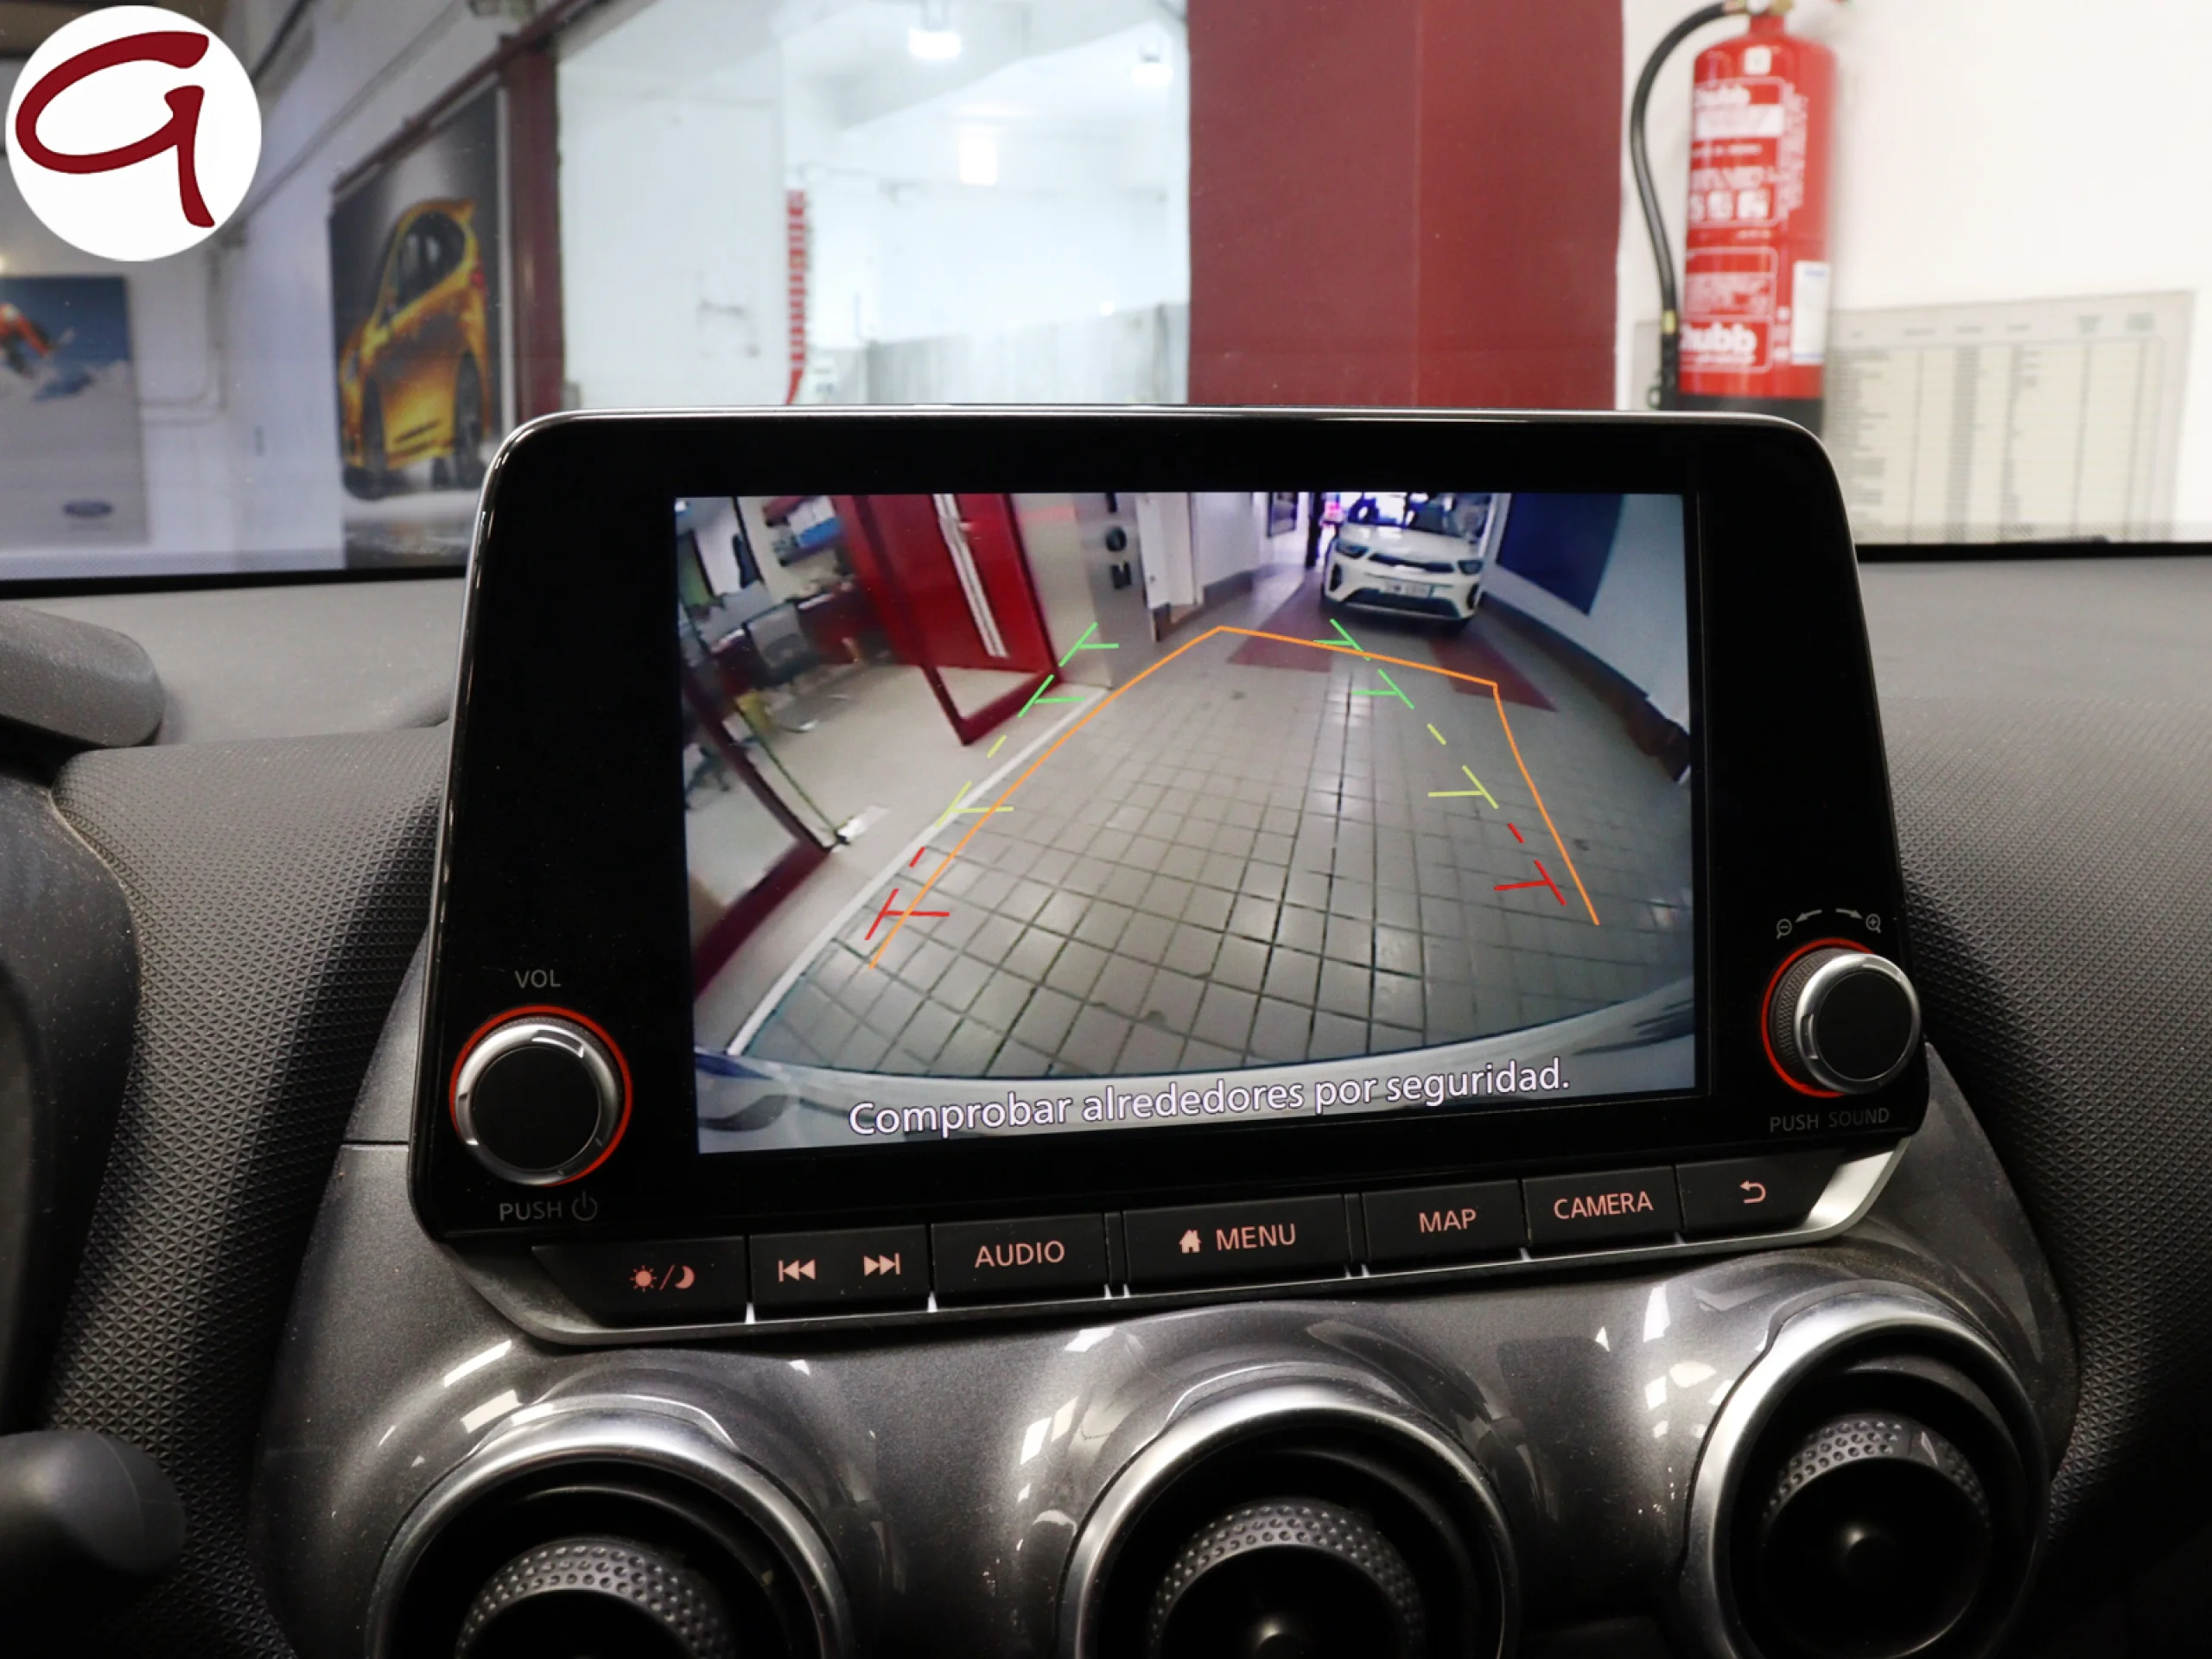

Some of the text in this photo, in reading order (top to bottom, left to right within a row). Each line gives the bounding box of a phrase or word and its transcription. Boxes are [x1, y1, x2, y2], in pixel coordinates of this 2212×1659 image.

[514, 969, 561, 988] VOL
[849, 1057, 1570, 1139] Comprobar alrededores por seguridad.
[1770, 1108, 1890, 1133] PUSH SOUND
[499, 1200, 563, 1222] PUSH
[1554, 1191, 1654, 1220] CAMERA
[1419, 1208, 1477, 1234] MAP
[1216, 1223, 1296, 1251] MENU
[975, 1240, 1065, 1268] AUDIO
